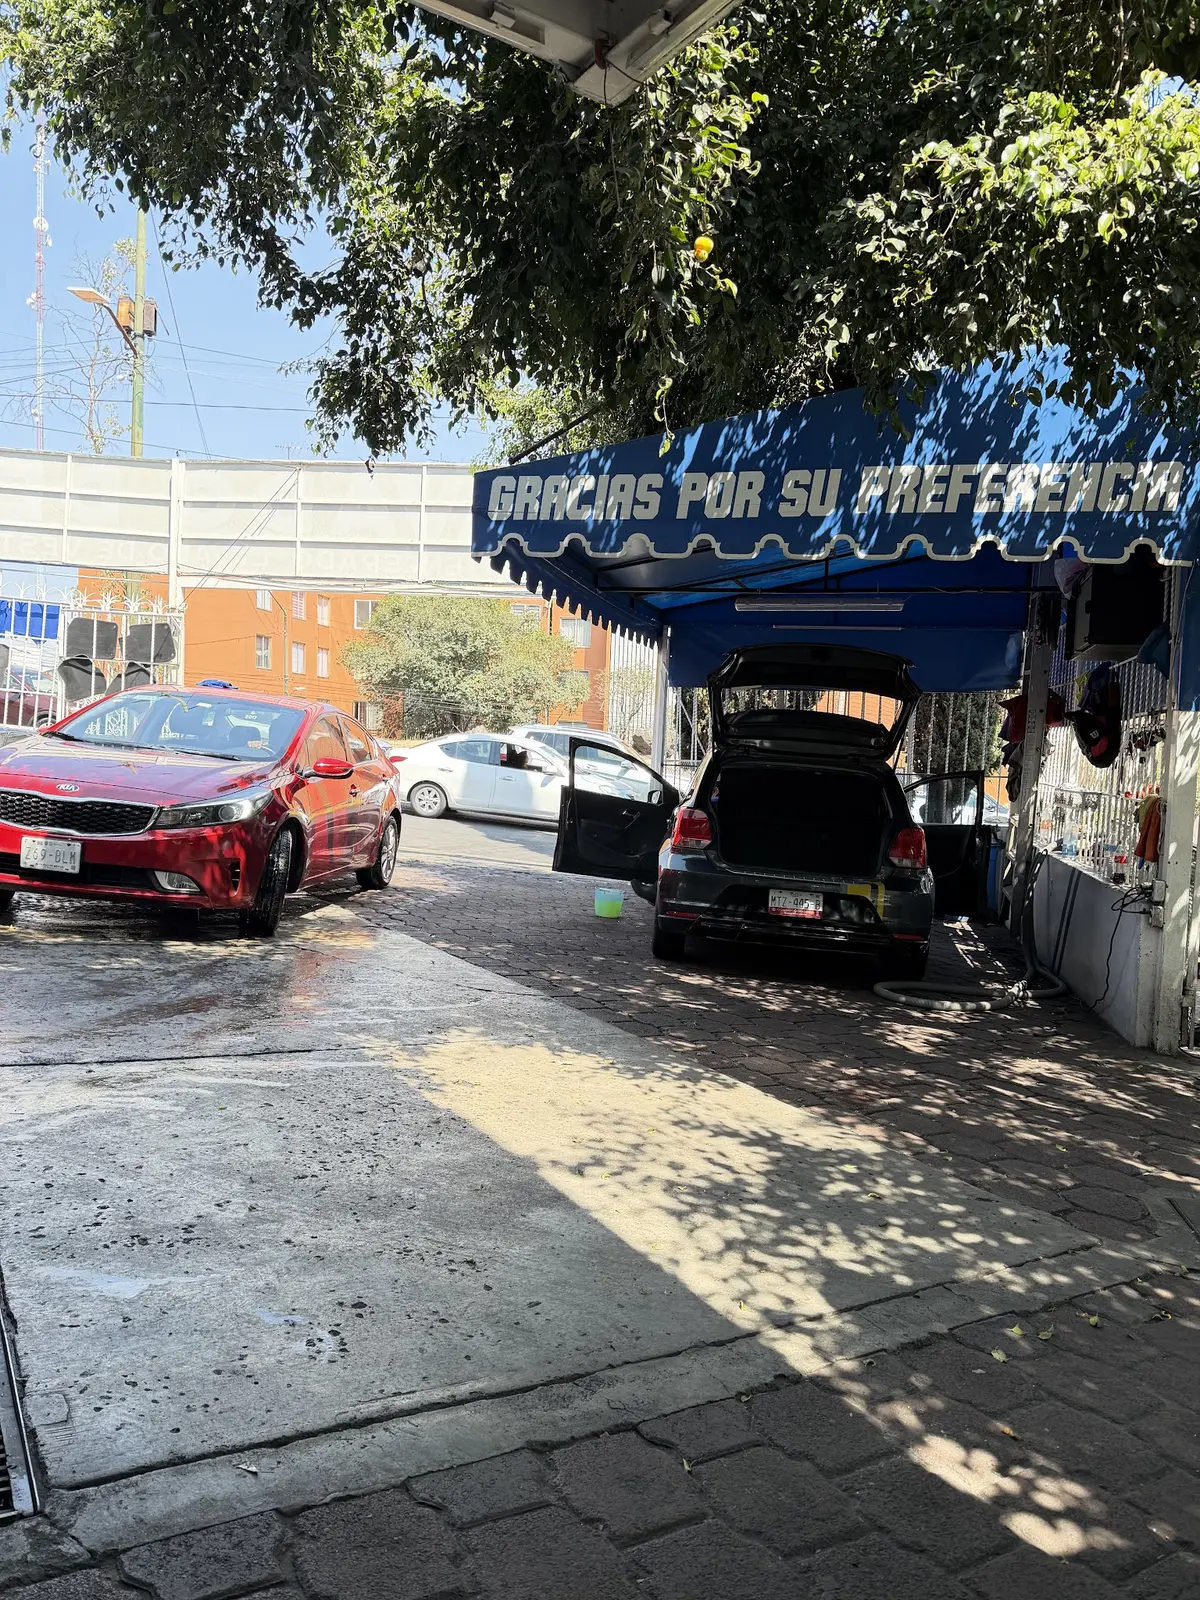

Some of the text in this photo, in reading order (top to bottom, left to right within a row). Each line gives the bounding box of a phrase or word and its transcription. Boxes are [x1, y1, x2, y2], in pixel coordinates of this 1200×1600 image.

[488, 461, 1185, 521] GRACIAS POR SU PREFERENCIA
[55, 782, 79, 791] KIA
